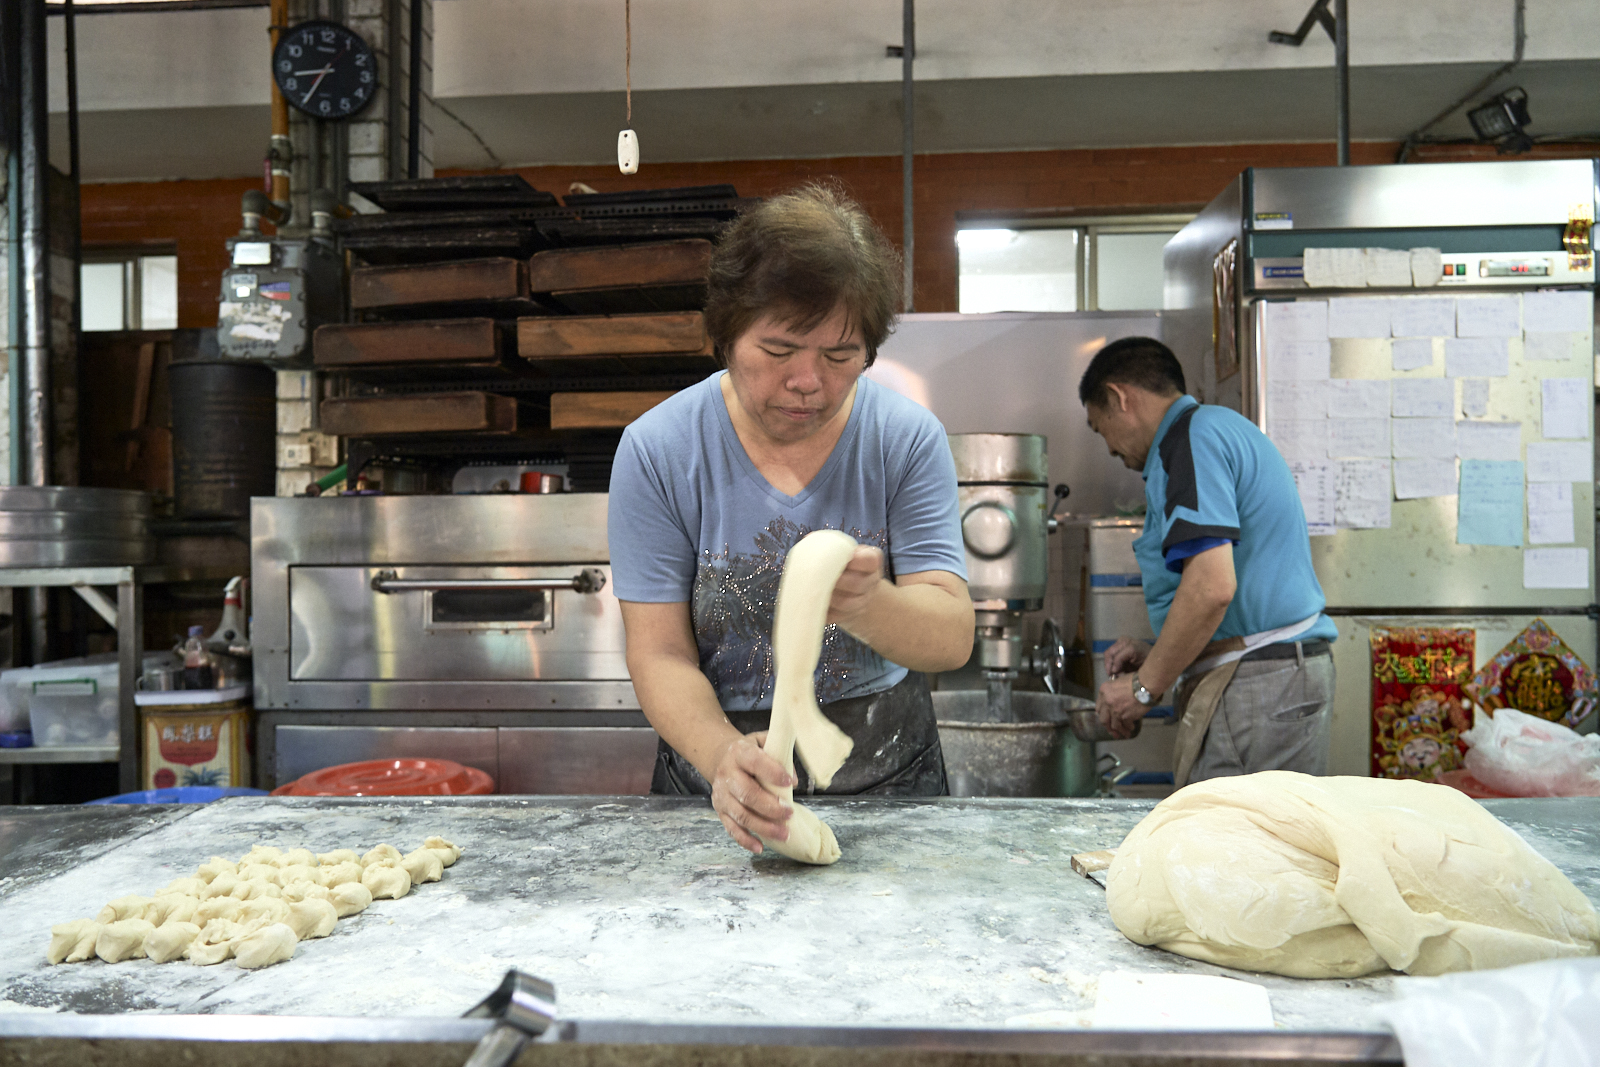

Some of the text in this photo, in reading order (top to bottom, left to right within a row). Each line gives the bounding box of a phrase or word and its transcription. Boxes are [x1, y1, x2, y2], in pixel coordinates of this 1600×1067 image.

[303, 33, 314, 46] 11
[322, 31, 336, 44] 12
[345, 37, 351, 51] 1
[288, 45, 302, 58] 10
[281, 60, 292, 73] 9
[356, 54, 366, 67] 2
[360, 71, 370, 83] 3
[286, 78, 297, 90] 8
[354, 87, 364, 98] 4
[320, 100, 331, 113] 6
[340, 98, 351, 111] 5
